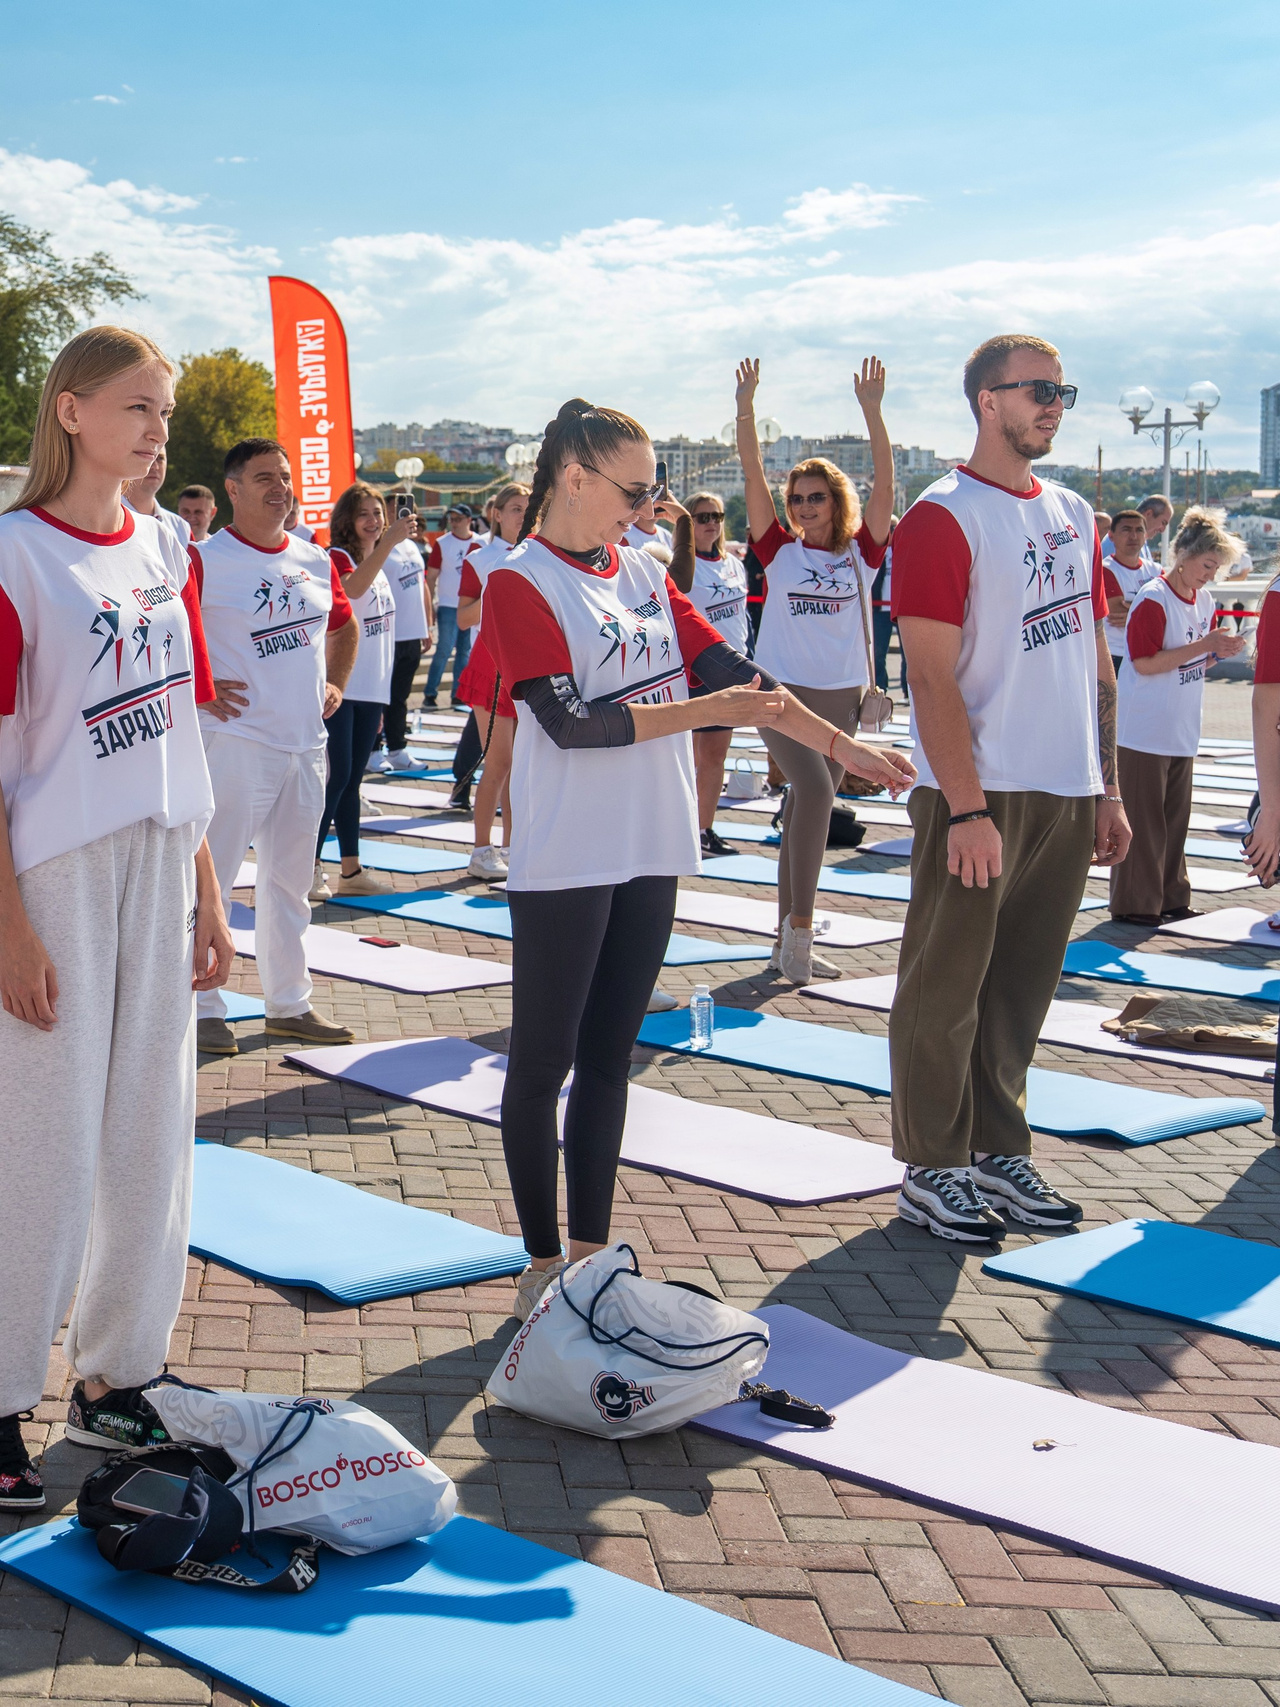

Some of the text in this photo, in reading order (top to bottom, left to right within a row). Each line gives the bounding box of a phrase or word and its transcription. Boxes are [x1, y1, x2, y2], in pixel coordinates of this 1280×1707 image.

[790, 601, 841, 616] ЗАРЯДКА
[253, 628, 311, 659] ЗАРЯДКА
[504, 1311, 541, 1382] BOSCO
[256, 1450, 426, 1508] BOSCO BOSCO
[341, 1516, 373, 1529] BOSCO.RU
